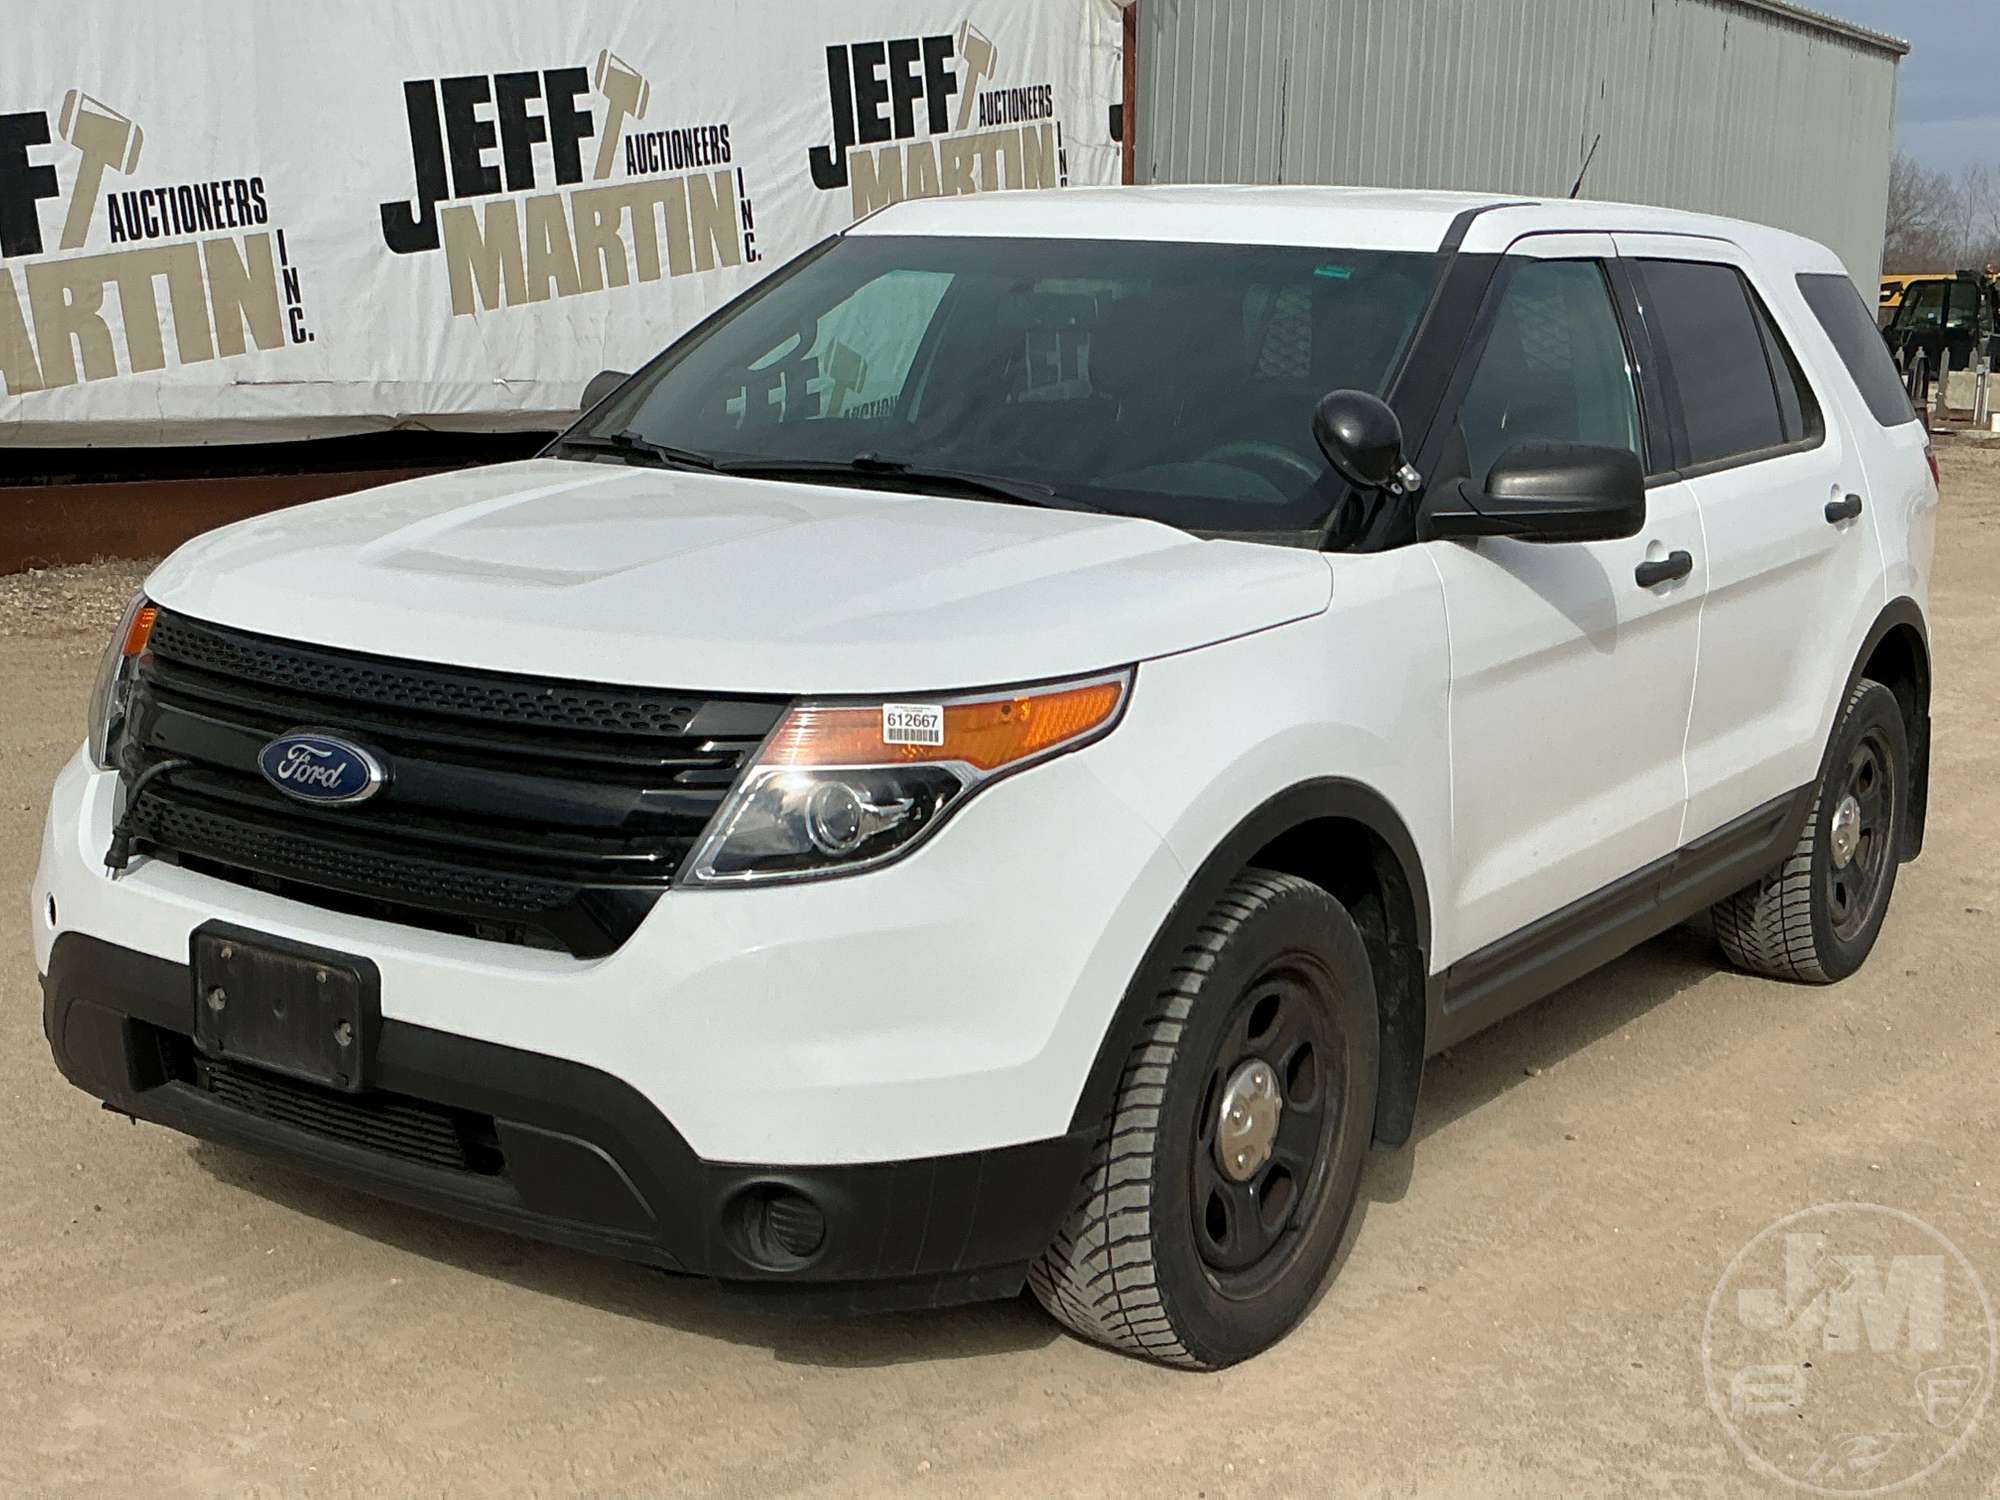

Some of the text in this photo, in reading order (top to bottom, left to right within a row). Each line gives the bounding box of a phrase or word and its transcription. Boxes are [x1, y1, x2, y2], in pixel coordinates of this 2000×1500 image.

[625, 124, 731, 176] AUCTIONEERS
[808, 35, 958, 190] JEFF
[979, 84, 1053, 127] AUCTIONEERS
[380, 67, 595, 254] JEFF
[850, 123, 1057, 221] MARTIN
[107, 177, 268, 243] AUCTIONEERS
[440, 170, 741, 316] MARTIN
[737, 167, 762, 263] INC.
[276, 229, 315, 344] INC.
[278, 744, 347, 789] Ford
[887, 713, 938, 728] 612667
